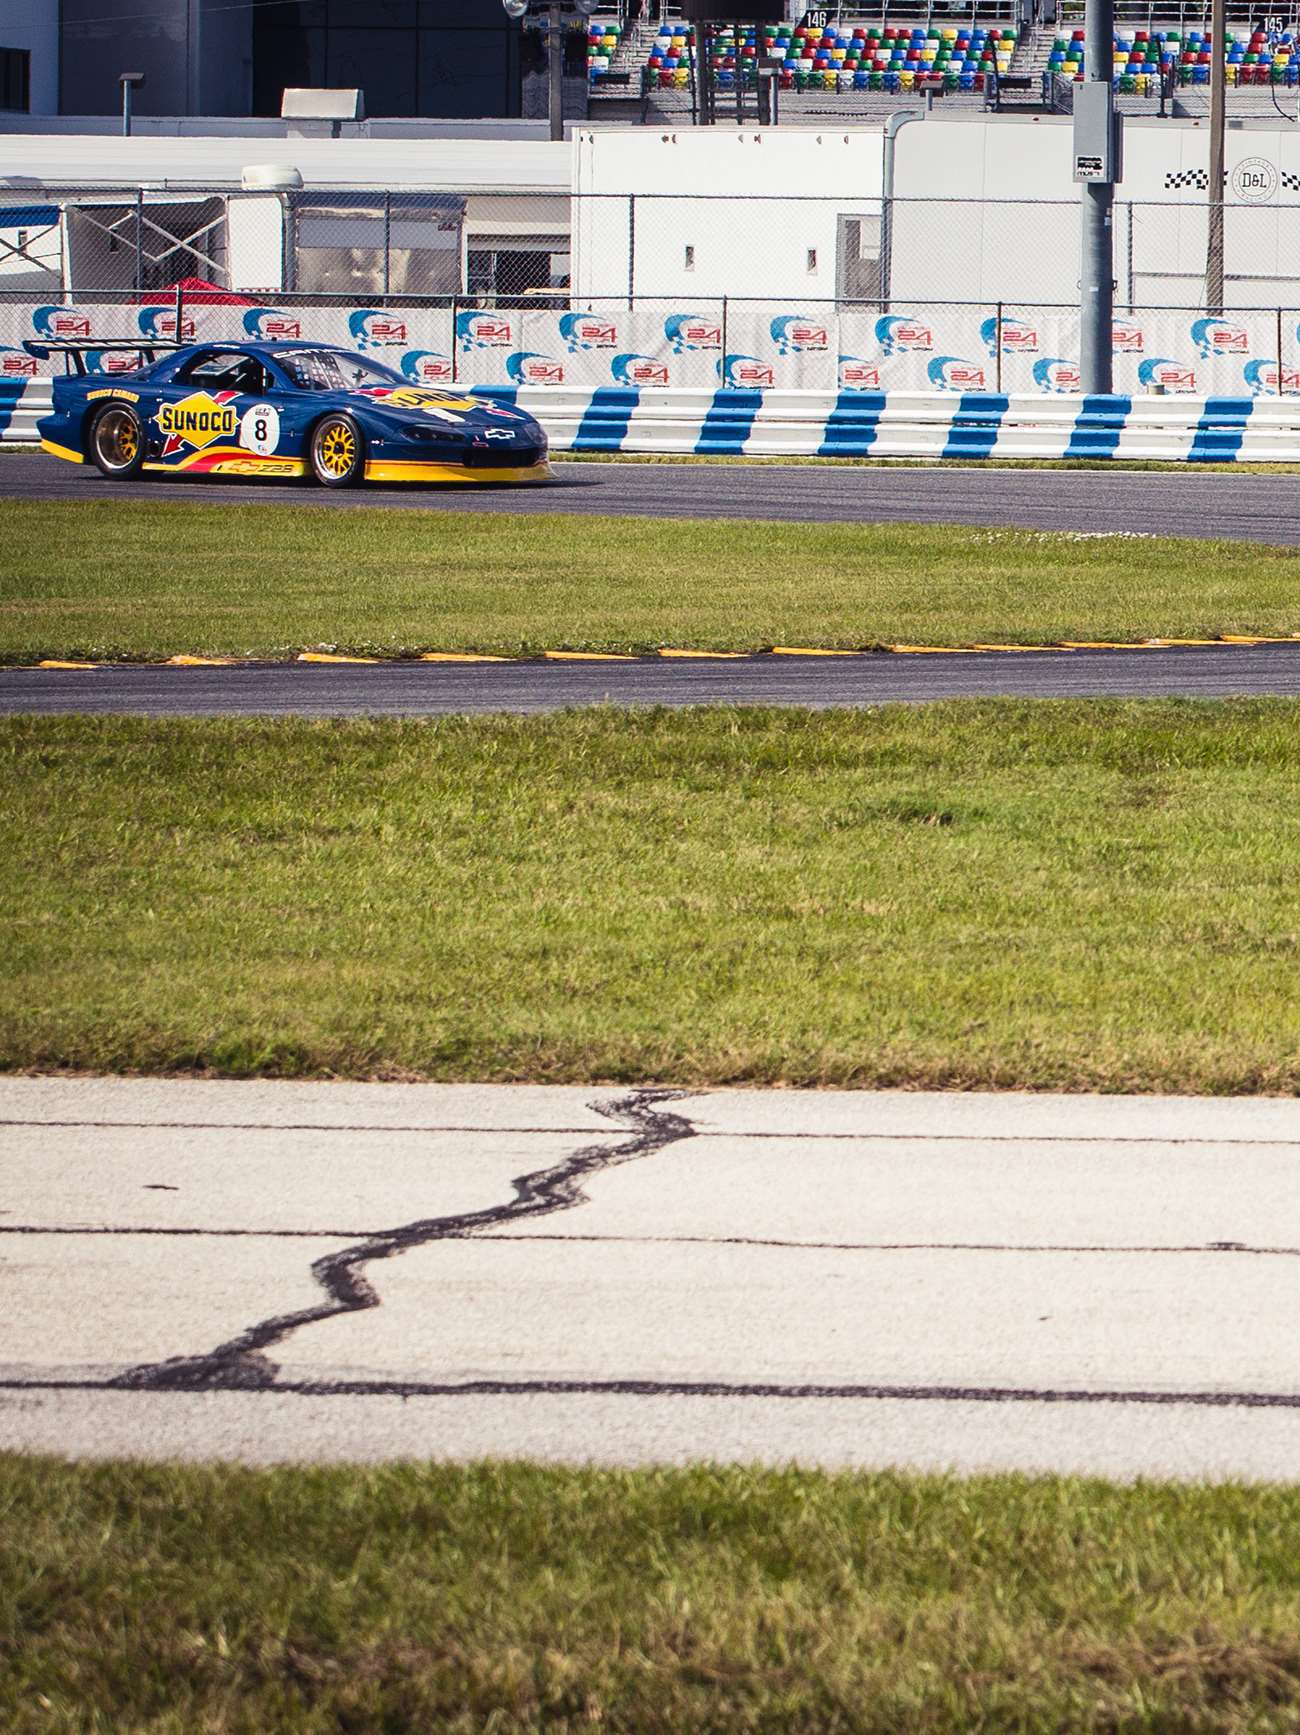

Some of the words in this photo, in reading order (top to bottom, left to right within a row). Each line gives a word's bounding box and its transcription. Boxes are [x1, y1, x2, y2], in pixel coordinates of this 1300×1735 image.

[806, 11, 827, 28] 146
[1264, 17, 1283, 32] 145
[1242, 172, 1267, 188] D&L
[56, 319, 91, 337] 24
[161, 320, 196, 337] 24
[266, 322, 302, 339] 24
[371, 323, 408, 340] 24
[476, 325, 513, 342] 24
[581, 326, 618, 343] 24
[687, 328, 721, 344] 24
[792, 328, 828, 345] 24
[897, 329, 934, 346] 24
[1002, 331, 1039, 347] 24
[1112, 331, 1144, 348] 24
[1213, 332, 1249, 349] 24
[162, 407, 233, 432] SUNOCO
[254, 419, 268, 441] 8
